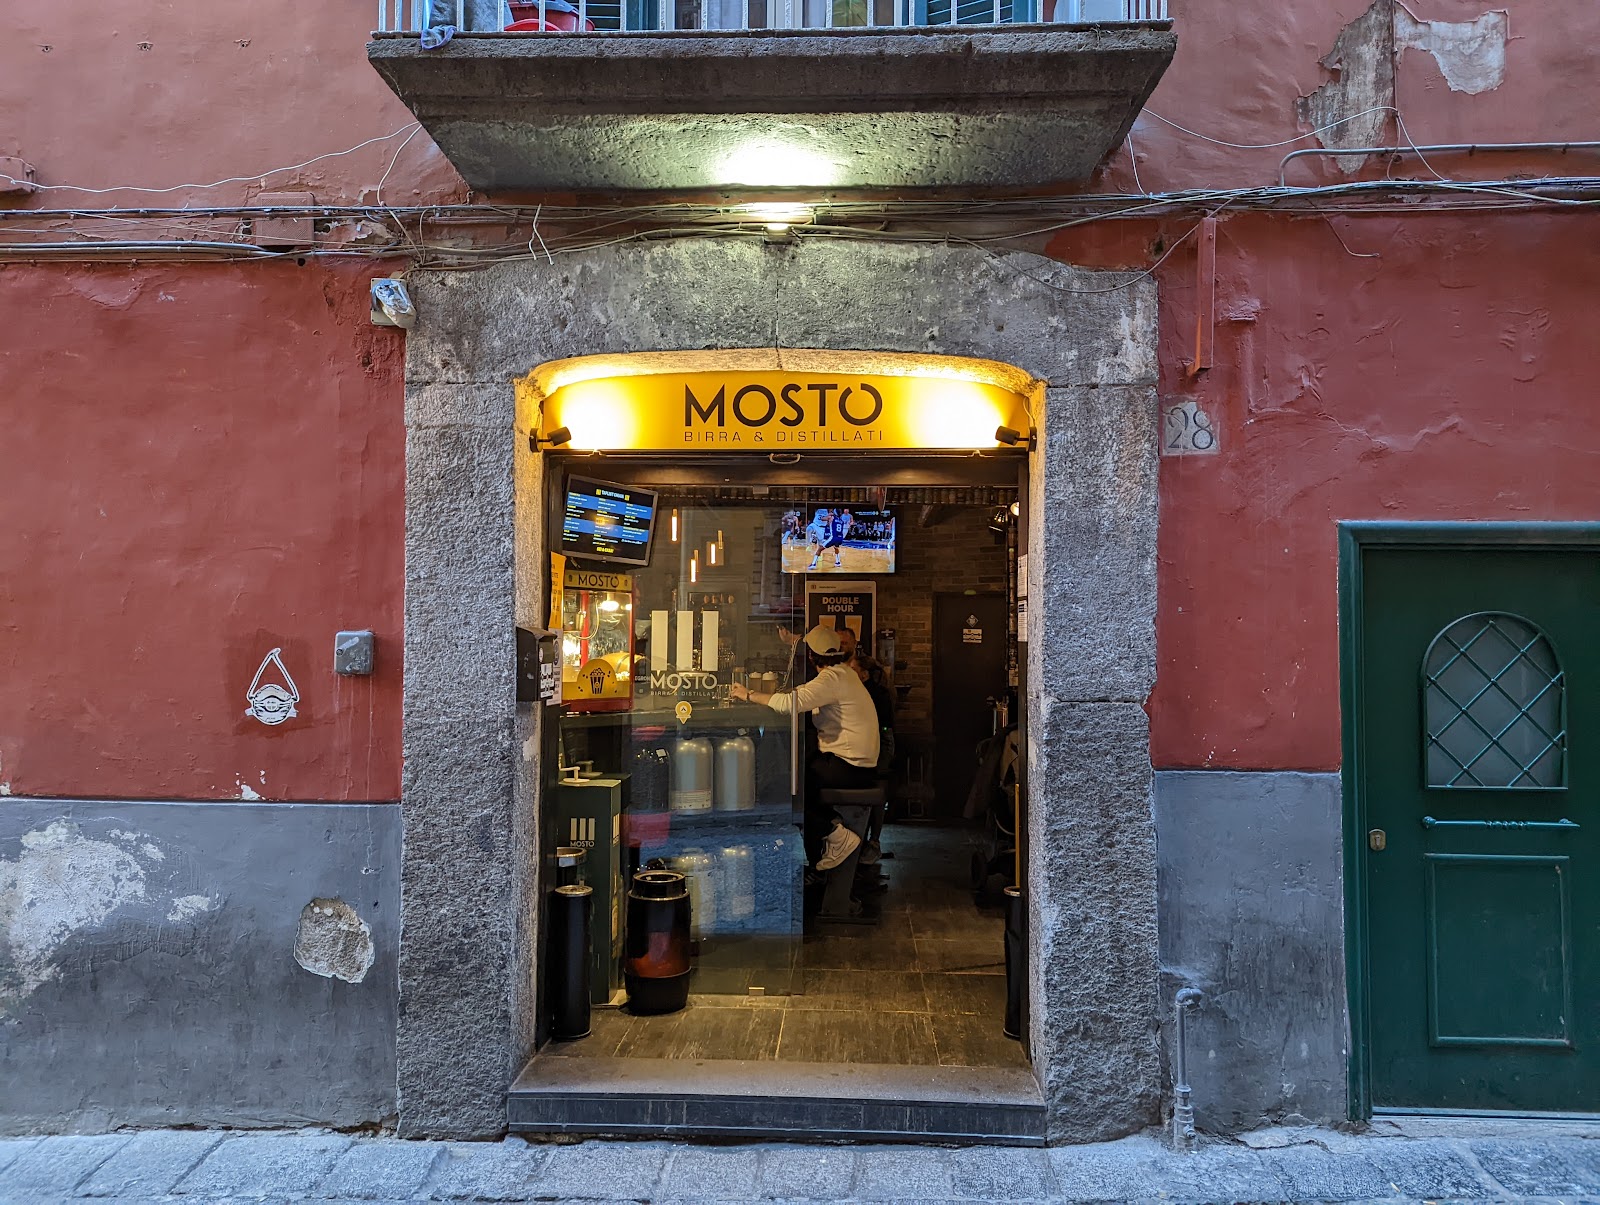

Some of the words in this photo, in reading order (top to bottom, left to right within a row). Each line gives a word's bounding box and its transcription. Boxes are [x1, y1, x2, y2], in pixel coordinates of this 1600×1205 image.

[685, 383, 883, 427] MOSTO
[1168, 406, 1213, 449] 28
[684, 431, 741, 442] BIRRA
[753, 431, 764, 442] &
[776, 430, 883, 442] DISTILLATI
[578, 574, 619, 588] MOSTO
[822, 597, 859, 605] DOUBLE
[650, 673, 718, 690] MOSTO
[570, 840, 595, 848] MOSTO
